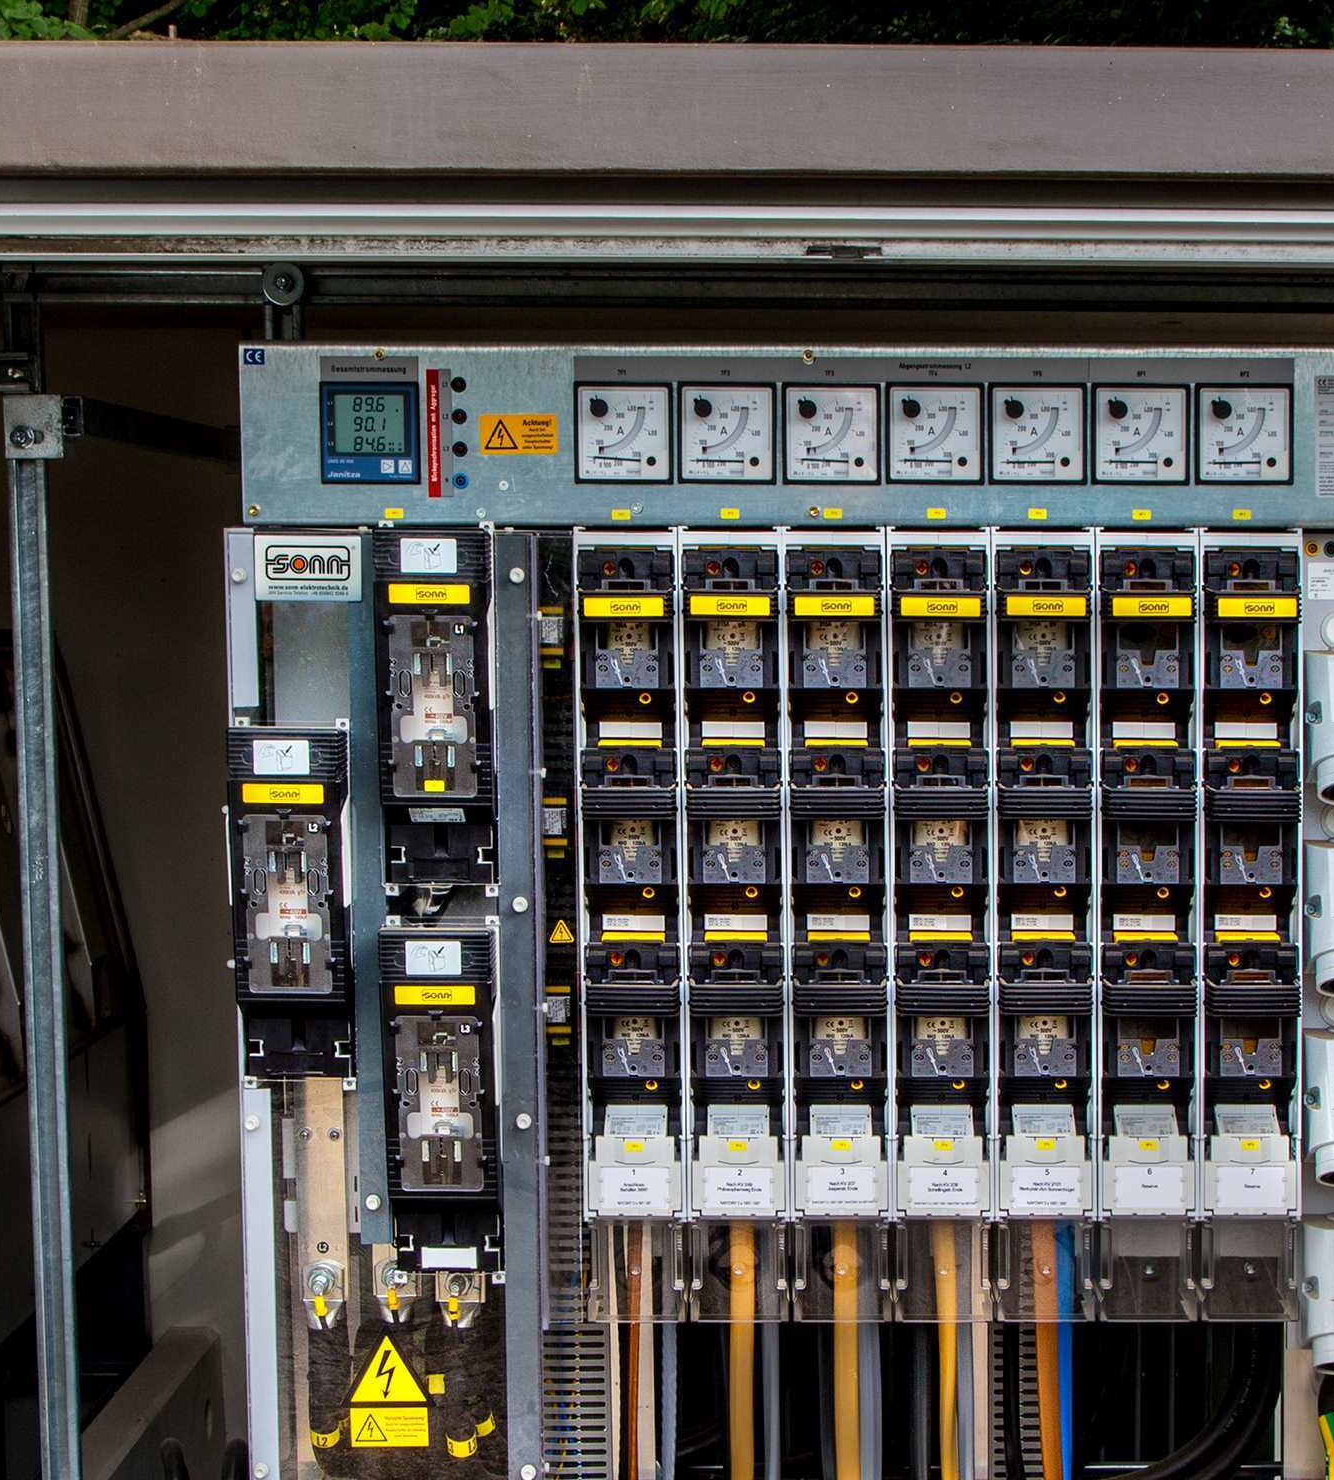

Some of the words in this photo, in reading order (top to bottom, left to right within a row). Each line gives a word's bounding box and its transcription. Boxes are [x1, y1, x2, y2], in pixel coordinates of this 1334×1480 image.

[245, 351, 263, 363] CE
[353, 397, 385, 412] 89.6
[353, 416, 386, 432] 90.1
[523, 419, 552, 427] Achtung!
[617, 427, 624, 436] A
[720, 427, 728, 436] A
[824, 427, 832, 436] A
[928, 427, 935, 436] A
[1030, 427, 1038, 436] A
[1133, 427, 1141, 436] A
[1237, 427, 1244, 436] A
[353, 436, 386, 452] 84.6
[270, 552, 347, 576] sonn
[455, 625, 463, 634] L1
[308, 823, 318, 833] L2
[460, 1024, 470, 1033] L3
